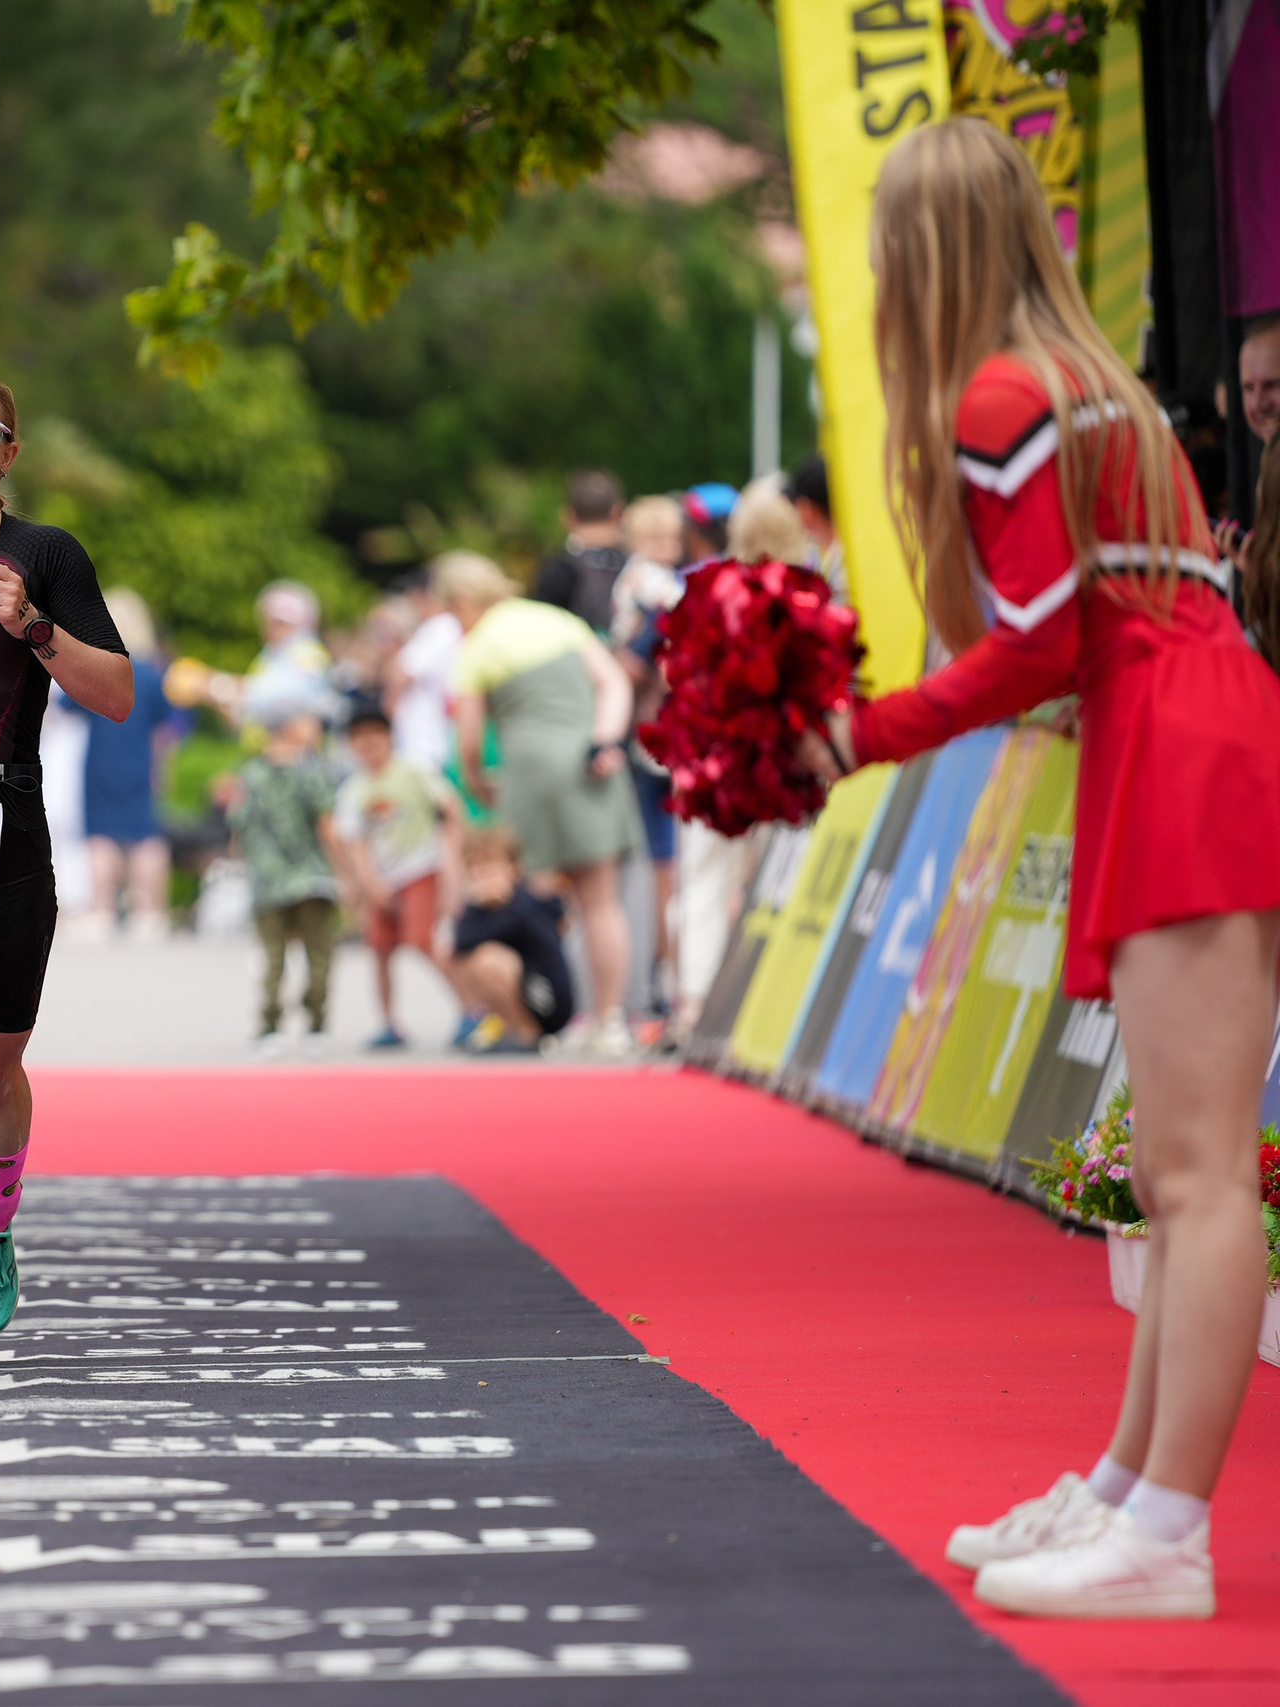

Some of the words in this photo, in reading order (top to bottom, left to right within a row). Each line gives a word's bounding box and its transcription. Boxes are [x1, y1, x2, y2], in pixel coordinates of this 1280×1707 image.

[84, 1341, 428, 1356] STAR
[86, 1366, 444, 1381] STAR
[109, 1435, 512, 1454] STAR
[135, 1527, 593, 1554] STAR
[156, 1643, 689, 1681] STAR
